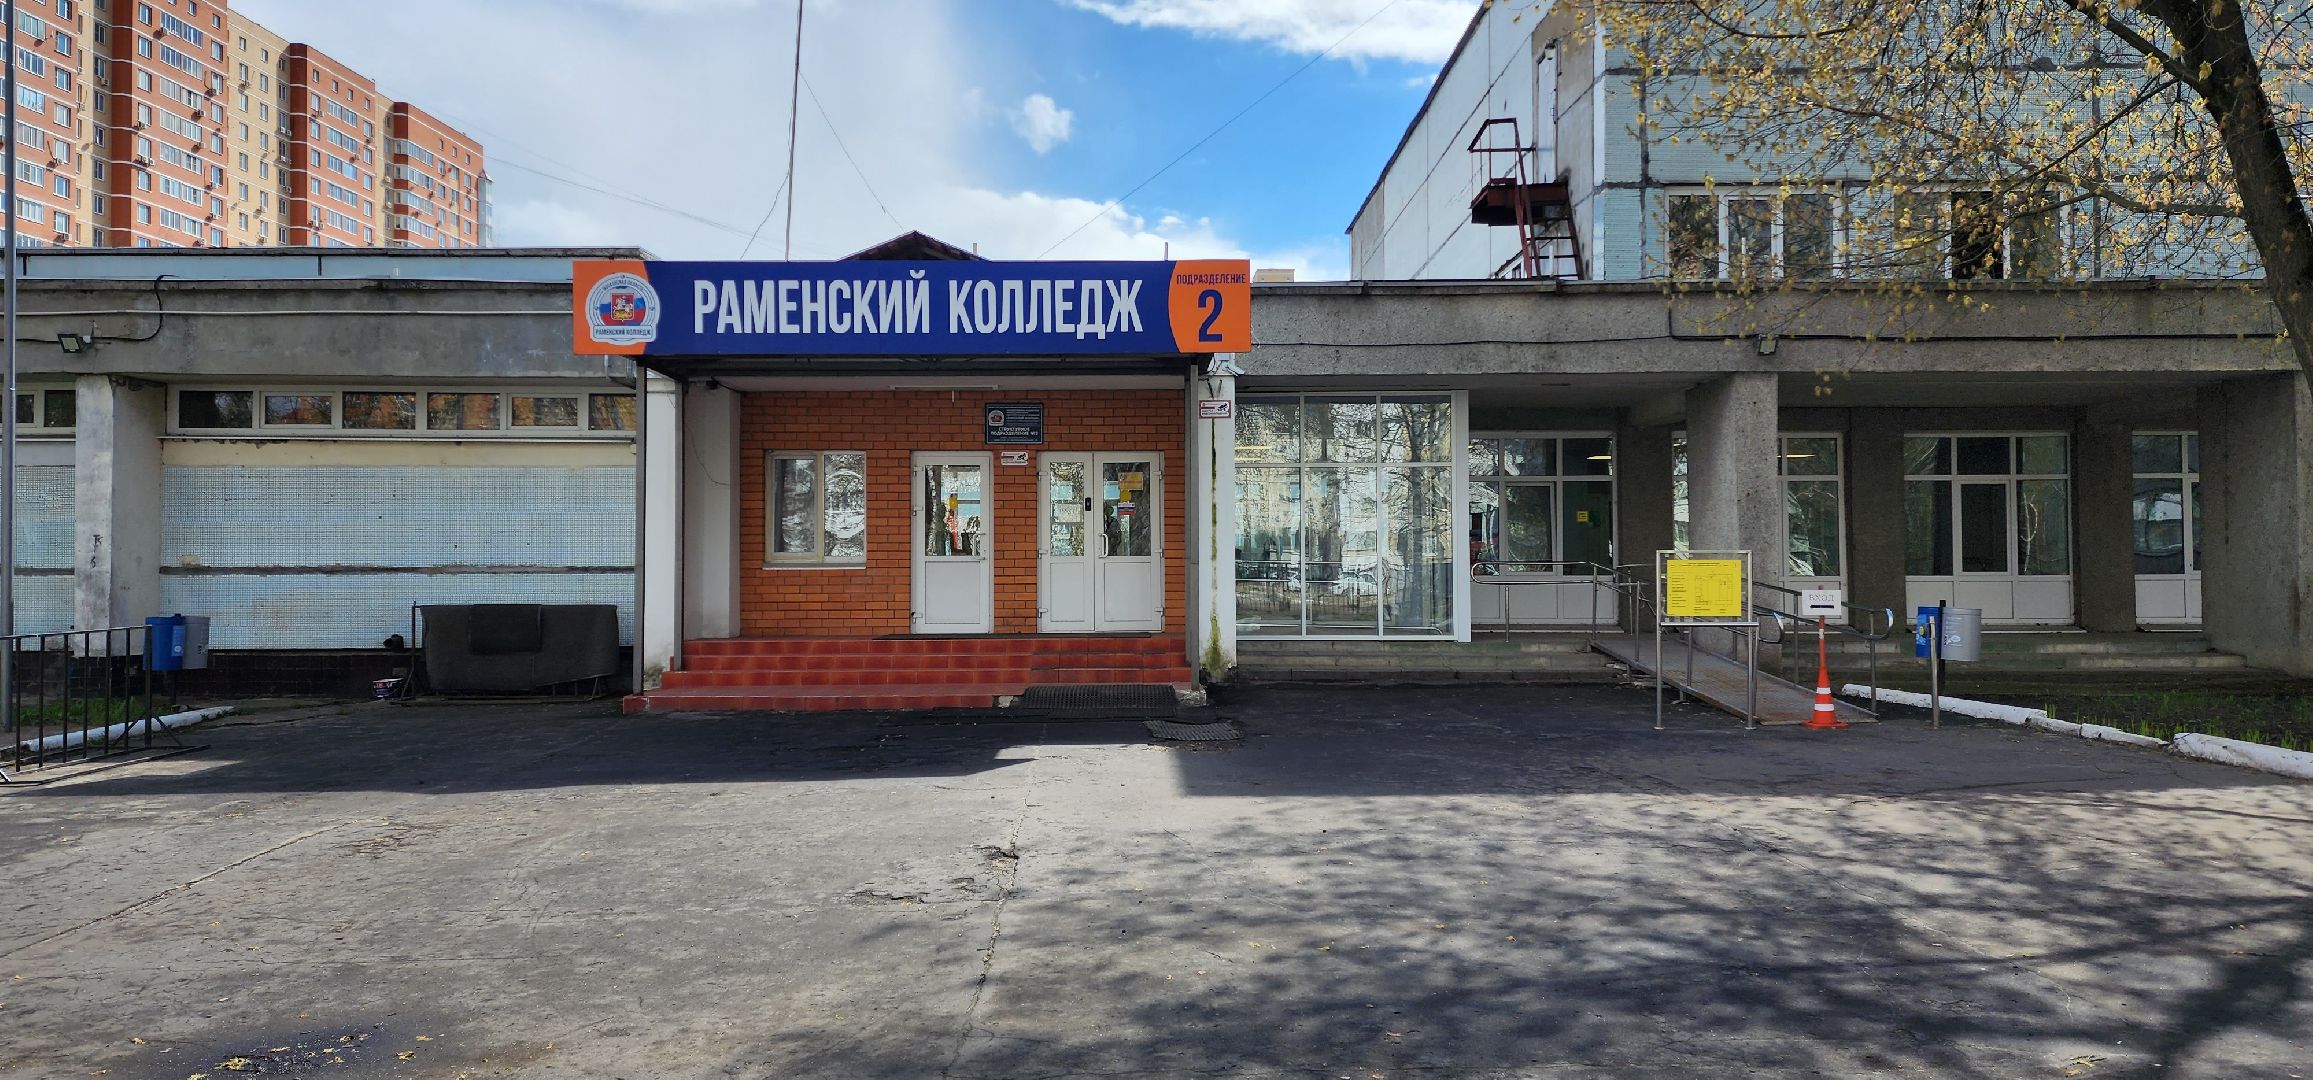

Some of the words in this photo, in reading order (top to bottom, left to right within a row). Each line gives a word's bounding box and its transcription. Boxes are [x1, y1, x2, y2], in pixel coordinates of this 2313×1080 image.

[1176, 273, 1246, 286] ПОДРАЗДЕЛЕНИЕ
[694, 269, 930, 333] РАМЕНСКИЙ
[949, 280, 1143, 339] КОЛЛЕДЖ
[1198, 289, 1223, 342] 2
[595, 327, 625, 336] РАМЕНСКИЙ
[626, 328, 651, 336] КОЛЛЕДЖ
[1808, 594, 1834, 602] ВХОД
